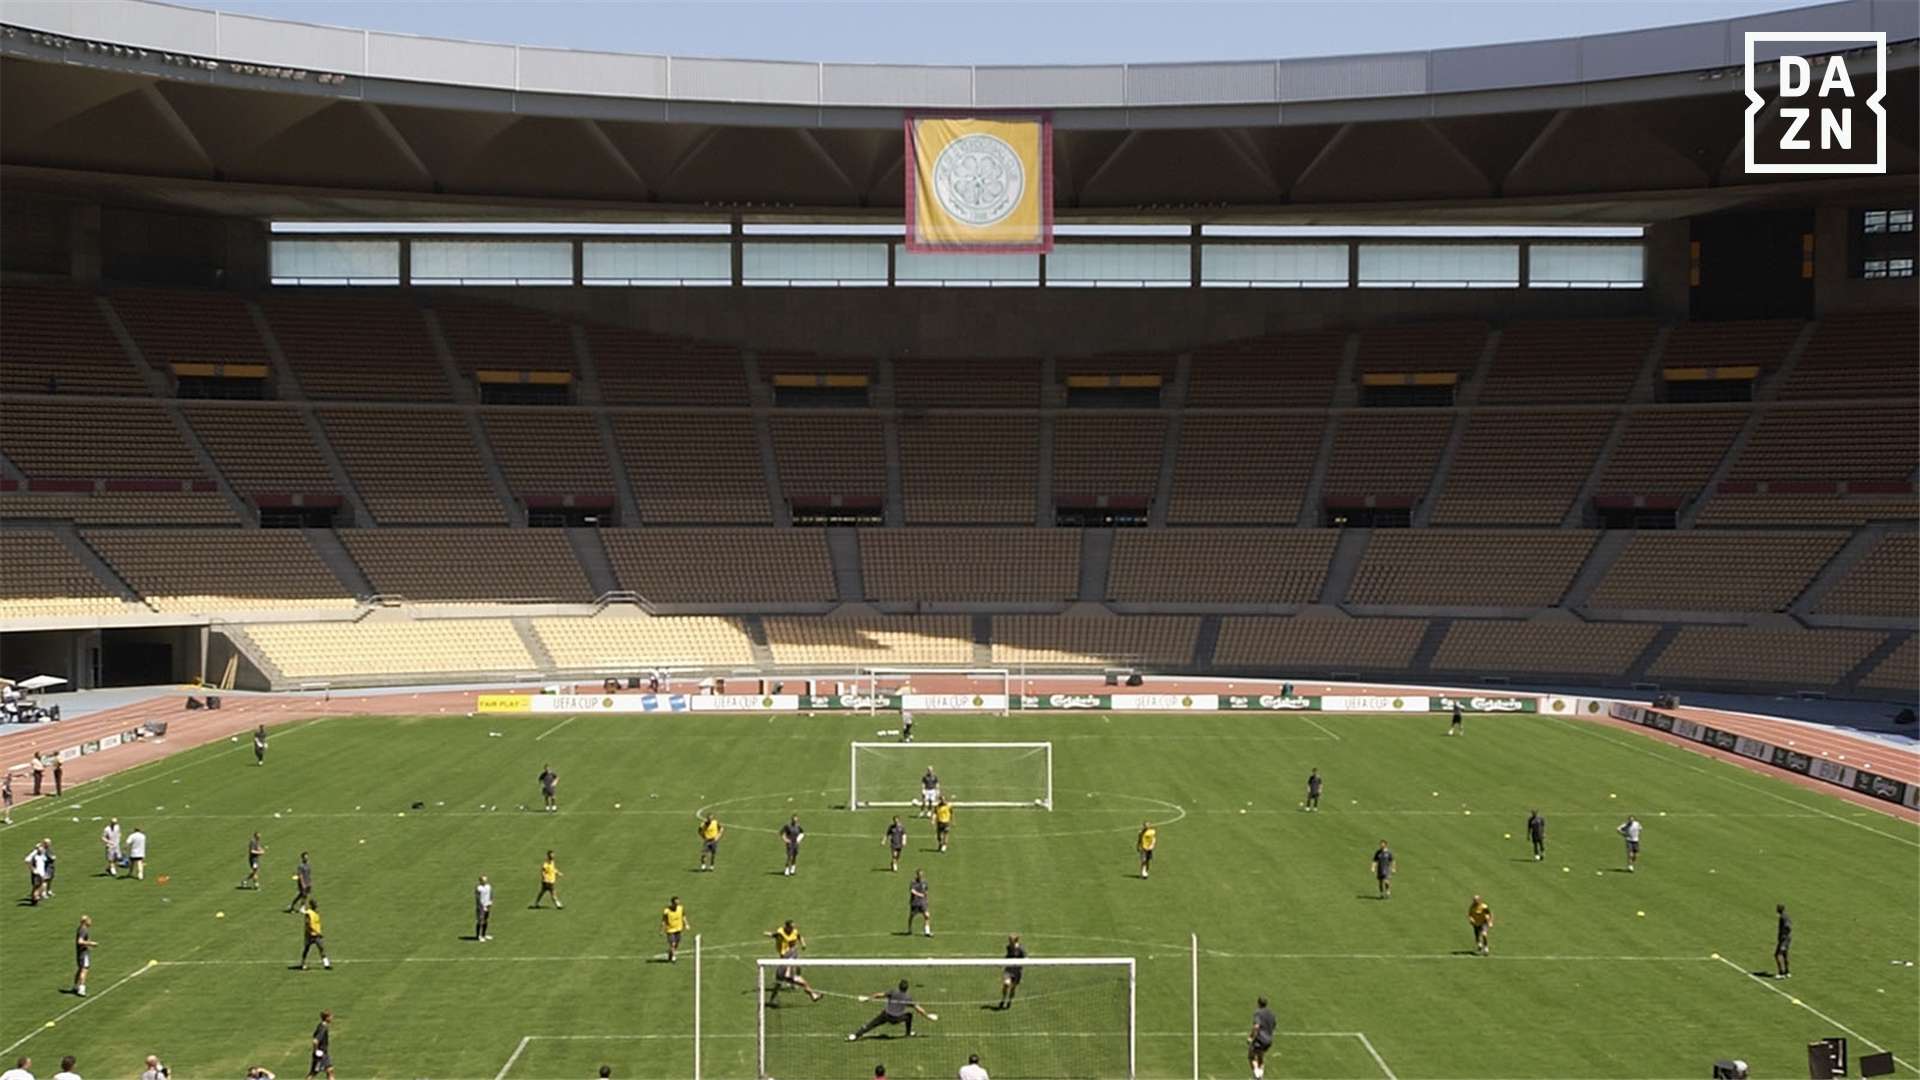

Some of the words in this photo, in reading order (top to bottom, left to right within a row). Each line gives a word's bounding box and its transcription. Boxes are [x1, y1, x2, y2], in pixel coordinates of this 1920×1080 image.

[480, 698, 498, 708] FAIR
[553, 697, 578, 709] UEFA
[579, 697, 599, 709] CUP
[713, 697, 737, 708] UEFA
[738, 697, 758, 708] CUP
[1050, 695, 1100, 708] Carlsberg
[1471, 698, 1522, 711] Carlsberg
